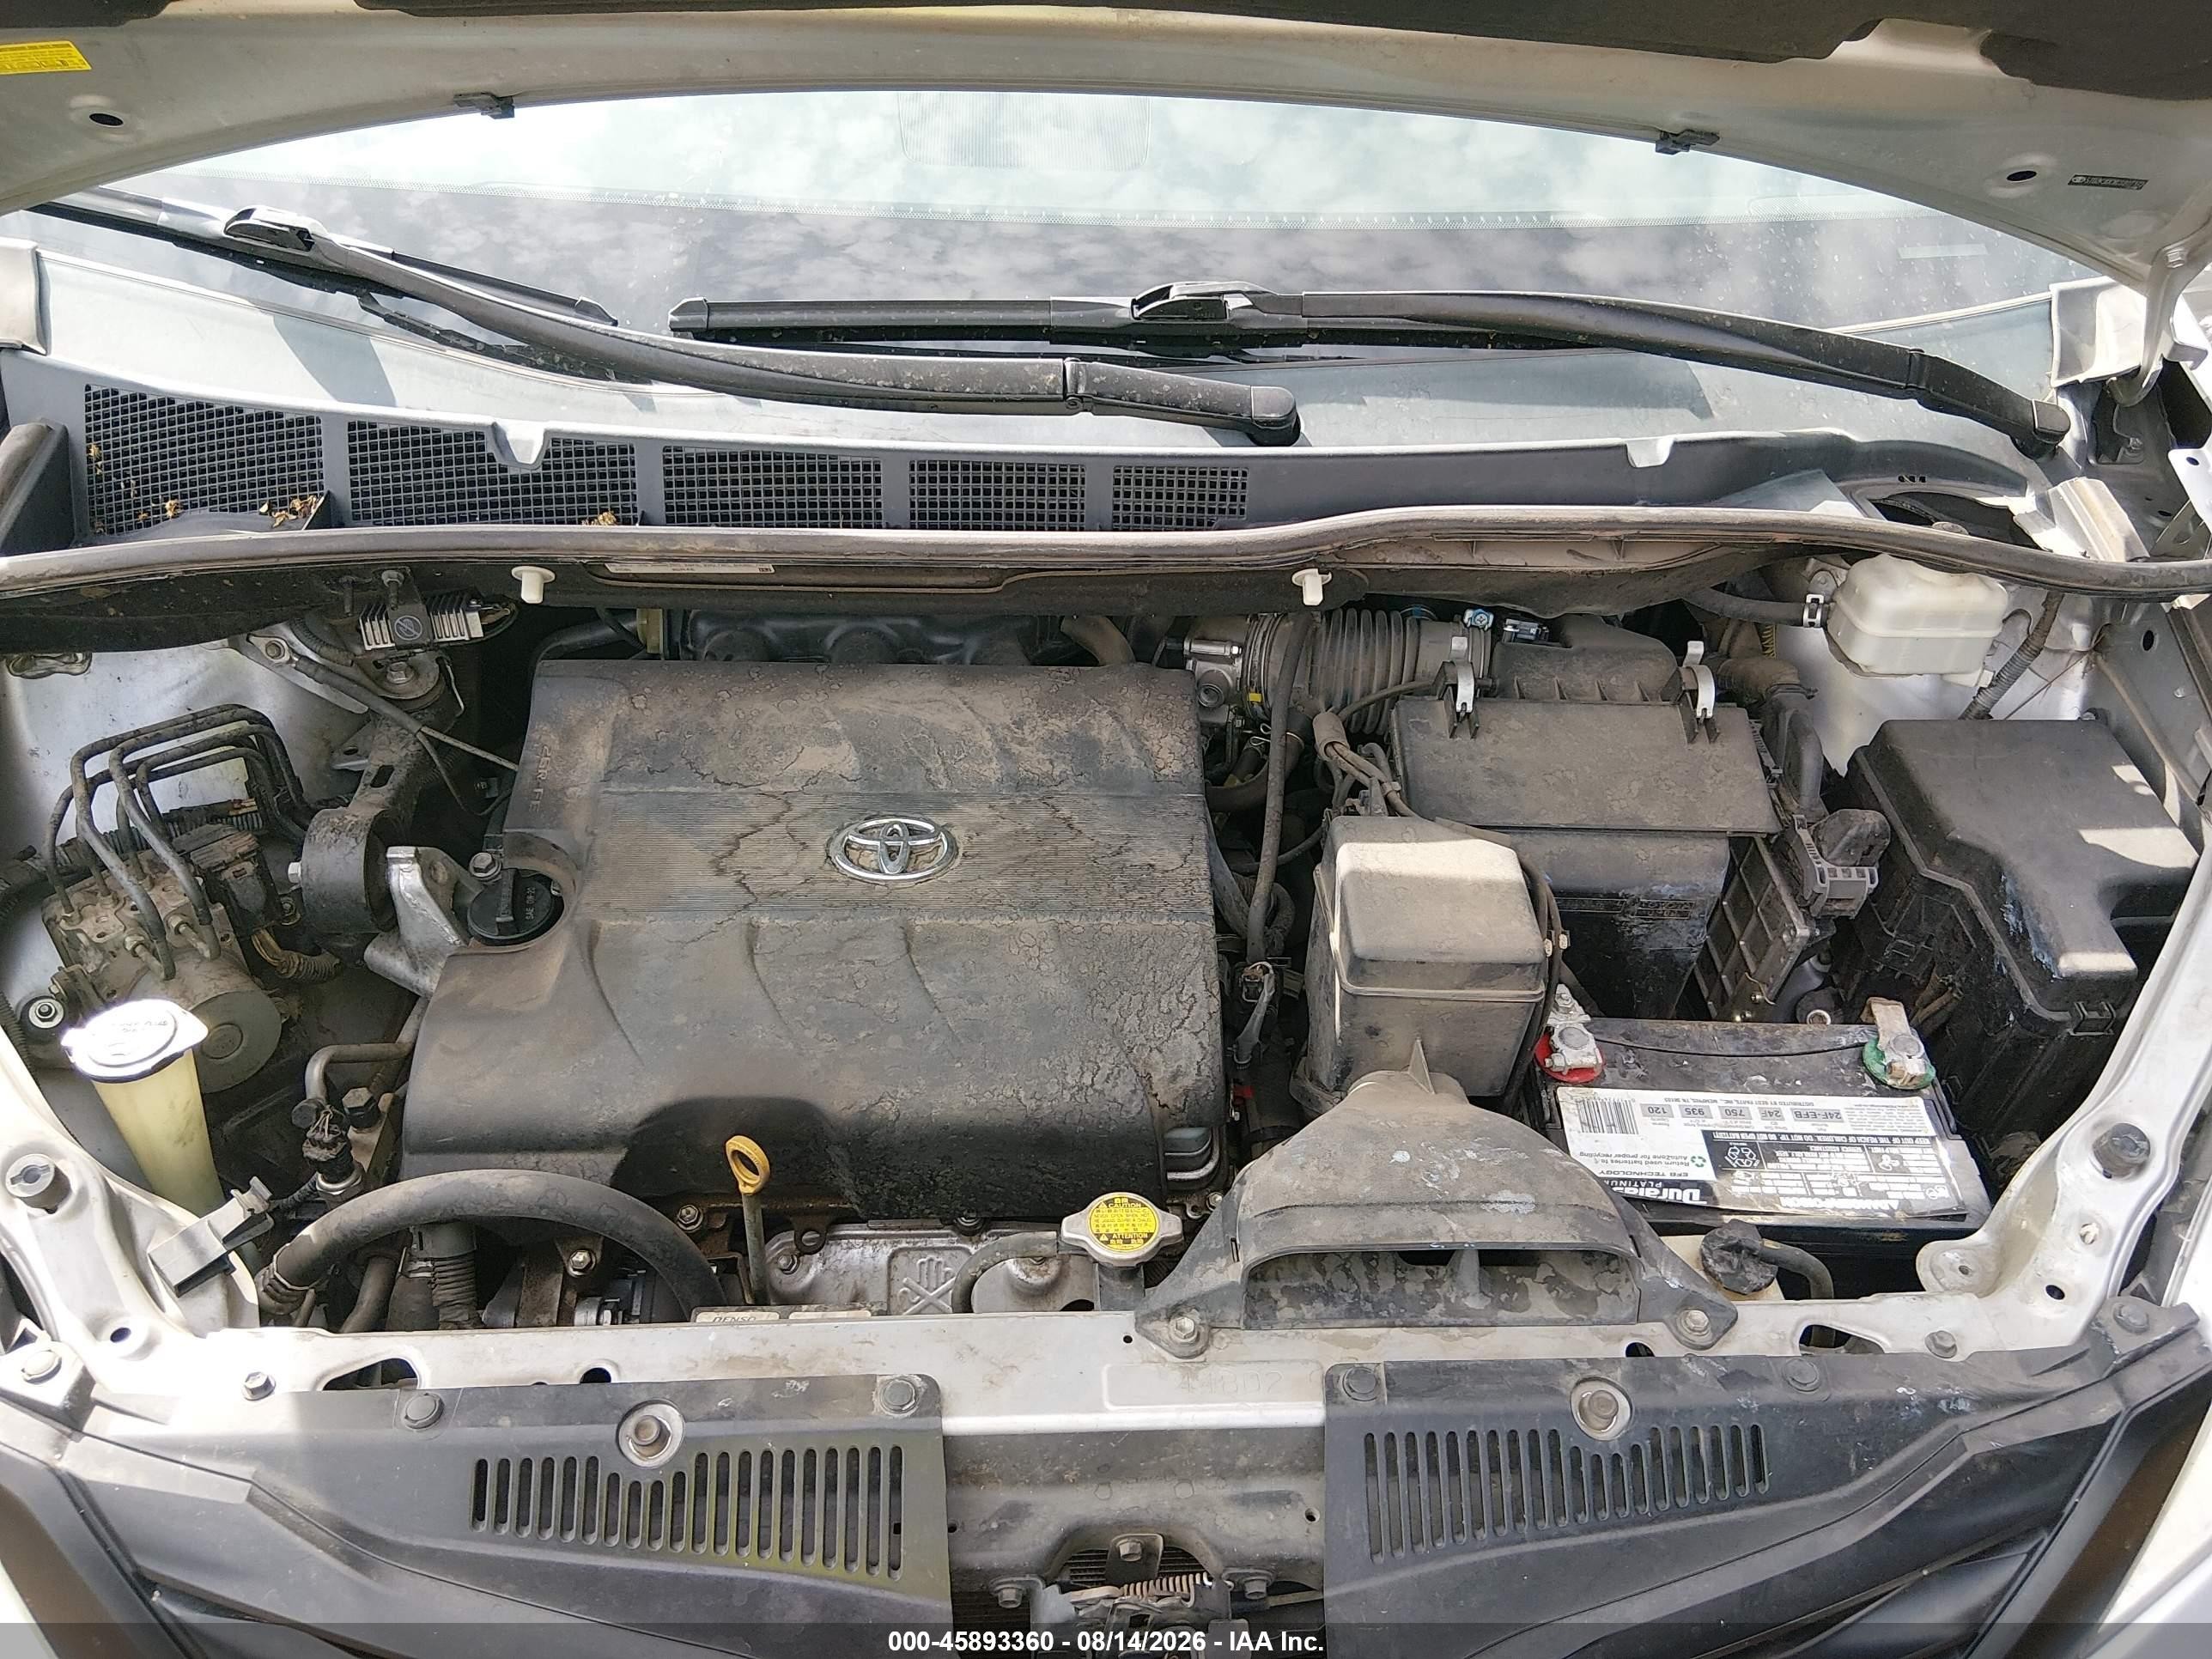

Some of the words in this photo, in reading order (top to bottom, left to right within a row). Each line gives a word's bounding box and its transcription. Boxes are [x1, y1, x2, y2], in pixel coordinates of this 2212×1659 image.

[526, 907, 535, 920] SAE
[1648, 1106, 1668, 1115] 120
[1761, 1109, 1782, 1118] 24F
[1794, 1110, 1843, 1120] 24F-EFB
[1612, 1187, 1708, 1205] Duralas
